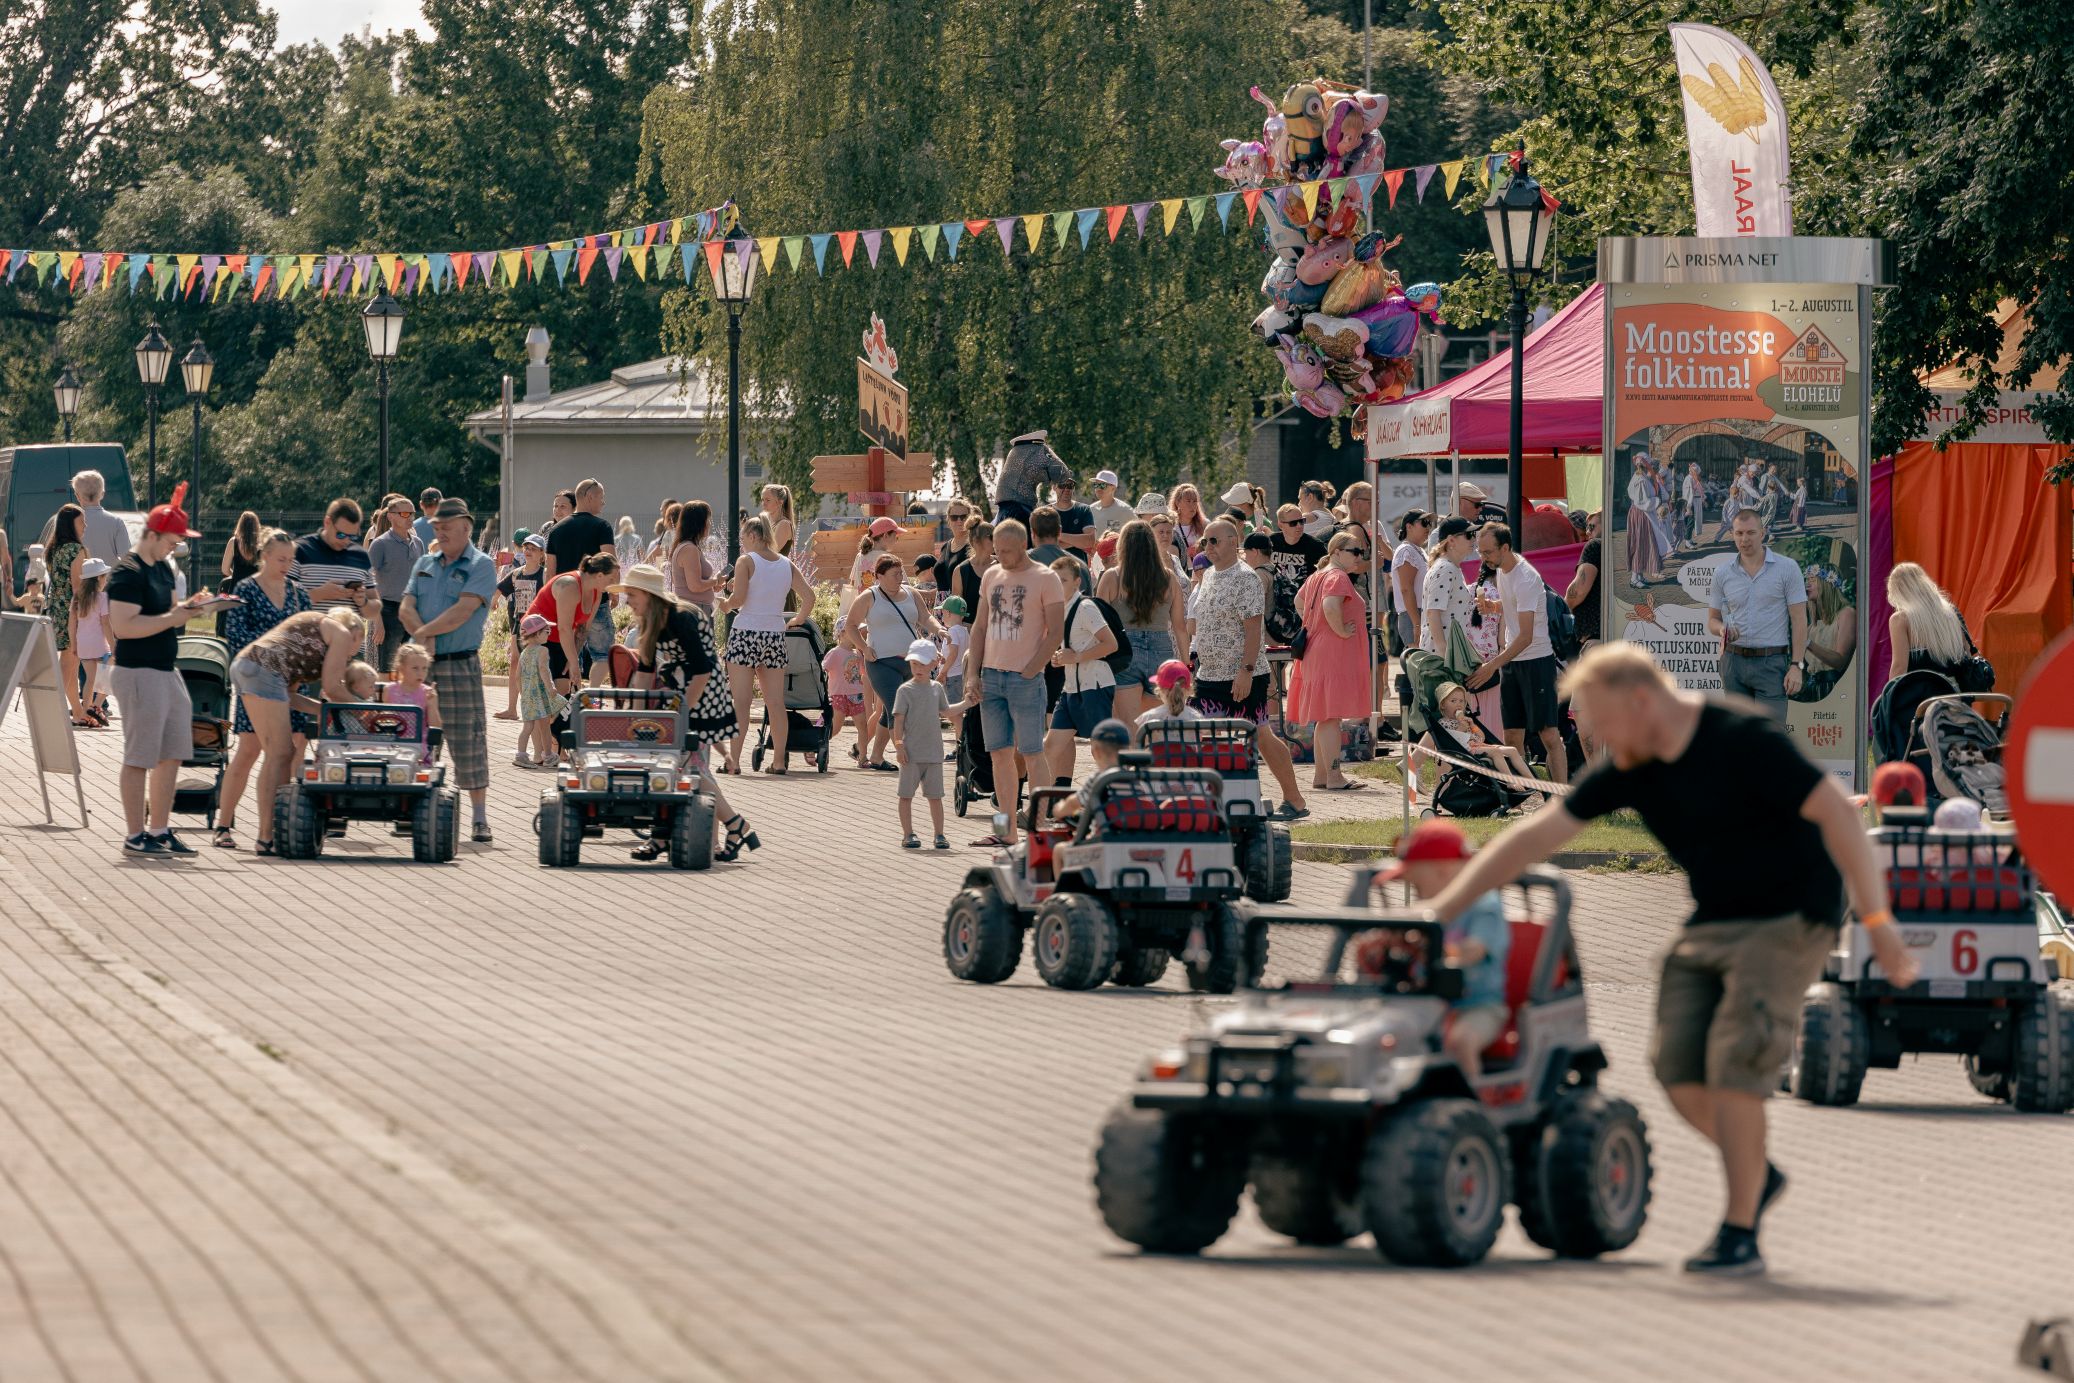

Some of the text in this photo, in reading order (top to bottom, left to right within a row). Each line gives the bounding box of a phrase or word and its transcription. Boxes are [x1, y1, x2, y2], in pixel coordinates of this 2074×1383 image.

[1685, 253, 1779, 267] PRISMA NET
[1801, 299, 1854, 312] AUGUSTIL
[1624, 322, 1775, 356] Moostesse
[1624, 356, 1751, 389] folkima!
[1784, 366, 1841, 383] MOOSTE
[1783, 385, 1842, 403] ELOHELÜ
[1271, 551, 1305, 566] GUESS
[1674, 622, 1705, 636] SUUR
[1684, 679, 1694, 689] 12
[1697, 678, 1724, 690] BÄND
[1176, 848, 1196, 884] 4
[1952, 928, 1979, 976] 6
